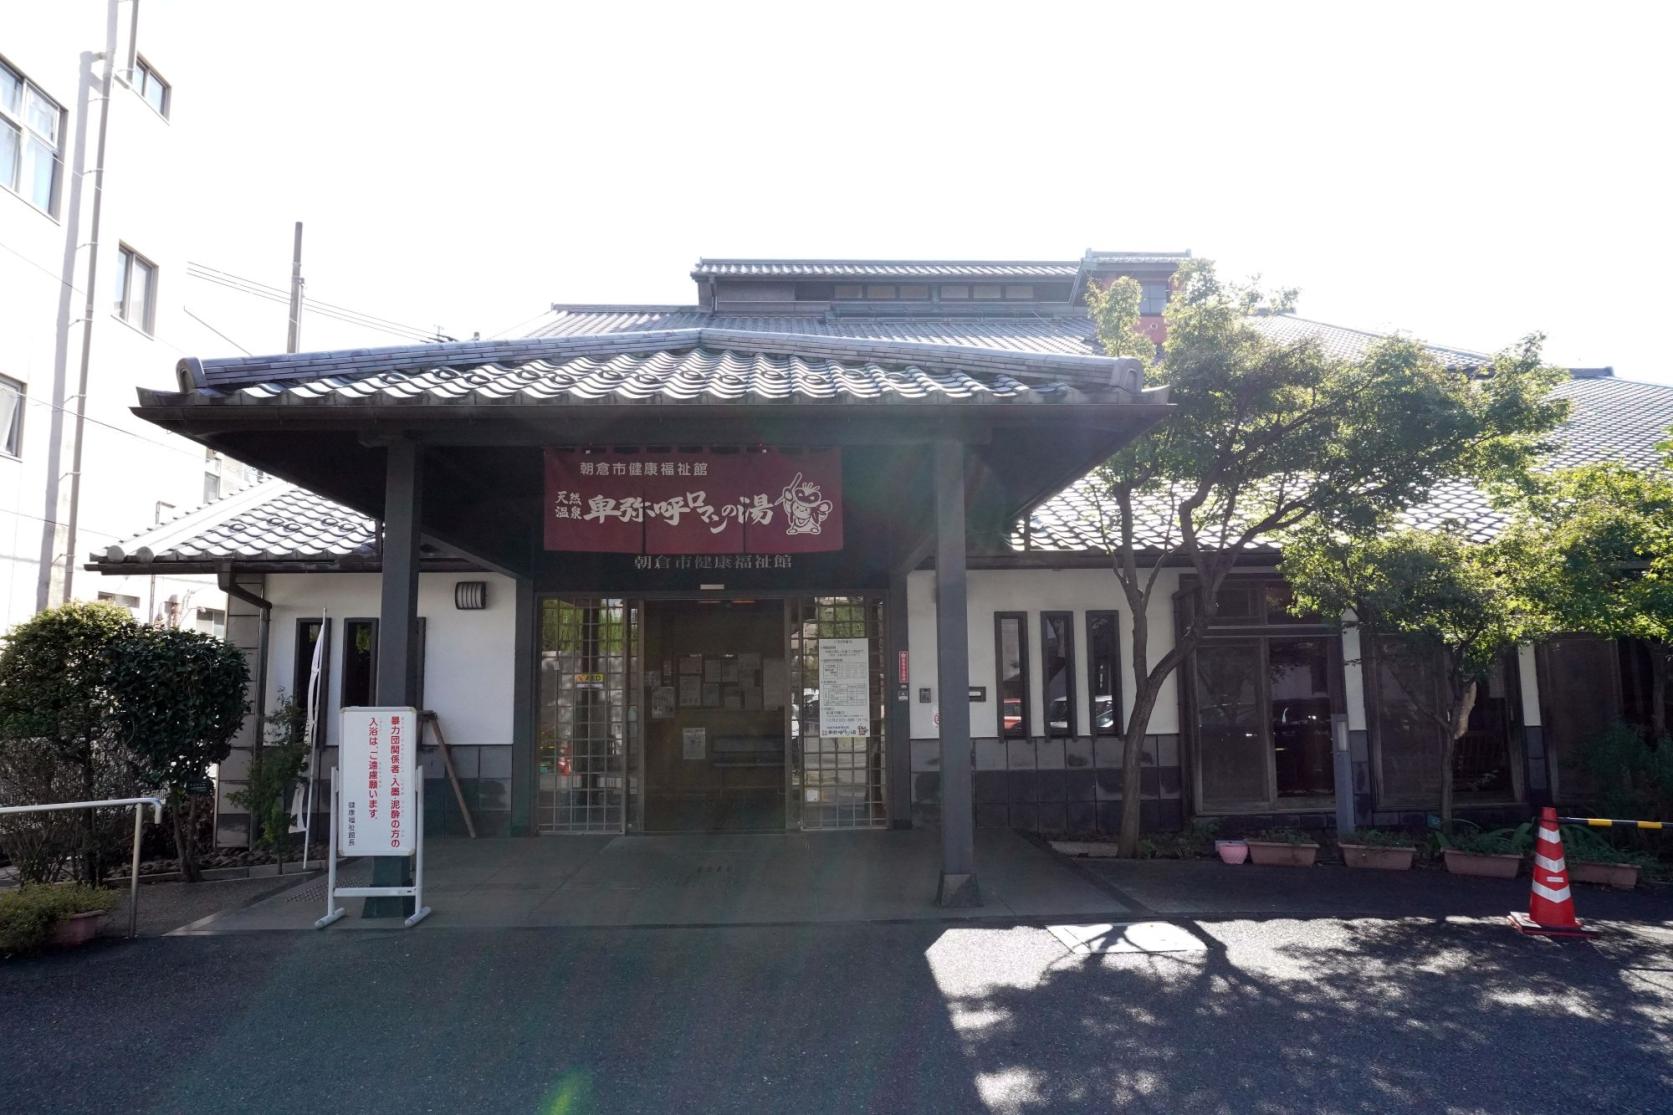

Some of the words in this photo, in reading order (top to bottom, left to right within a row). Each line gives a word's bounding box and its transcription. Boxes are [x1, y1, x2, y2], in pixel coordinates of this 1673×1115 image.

[580, 462, 708, 476] 朝倉市健康福祉館
[555, 491, 582, 505] 天然
[555, 506, 582, 520] 温泉
[634, 554, 793, 569] 朝倉市健康福祉館
